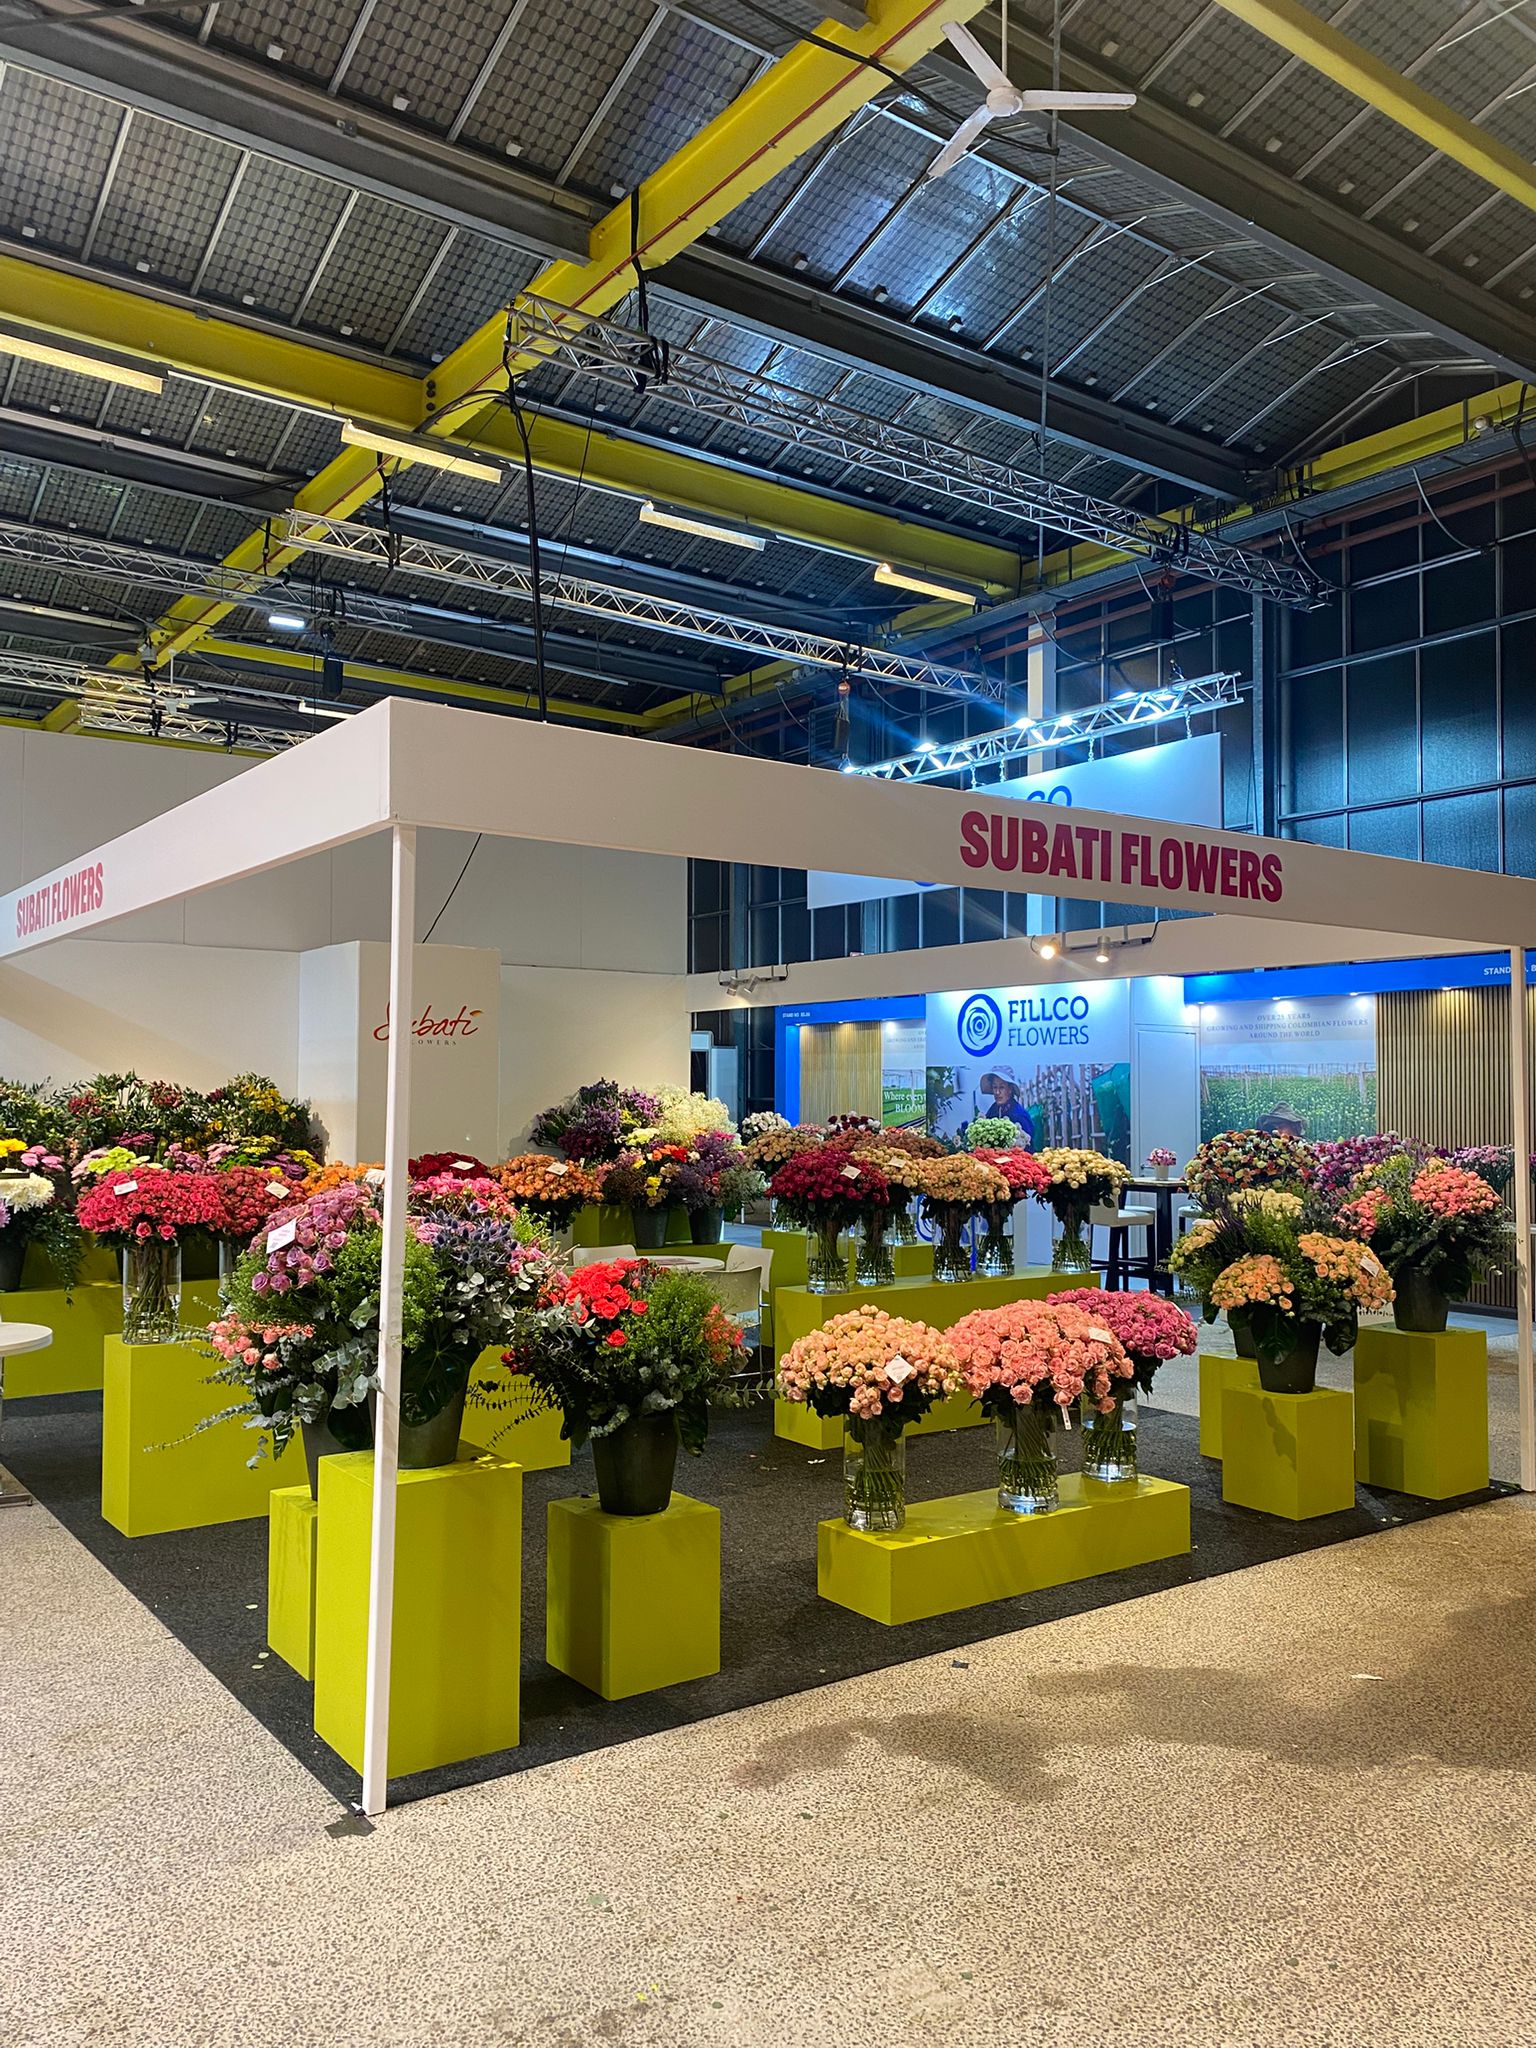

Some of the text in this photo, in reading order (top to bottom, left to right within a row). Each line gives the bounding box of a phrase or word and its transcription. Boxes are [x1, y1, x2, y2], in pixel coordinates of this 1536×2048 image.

[960, 810, 1283, 903] SUBATI FLOWERS
[16, 862, 104, 938] SUBATI FLOWERS
[1484, 967, 1511, 975] STAND
[1008, 995, 1089, 1023] FILLCO
[372, 1000, 480, 1041] Sbati
[1238, 1023, 1254, 1031] AND
[1254, 1022, 1286, 1031] SHIPPING
[1287, 1021, 1332, 1029] COLOMBIAN
[1332, 1019, 1369, 1027] FLOWERS
[1008, 1026, 1089, 1047] FLOWERS
[1250, 1031, 1278, 1039] AROUND
[1294, 1030, 1320, 1038] WORLD
[884, 1091, 905, 1101] Where
